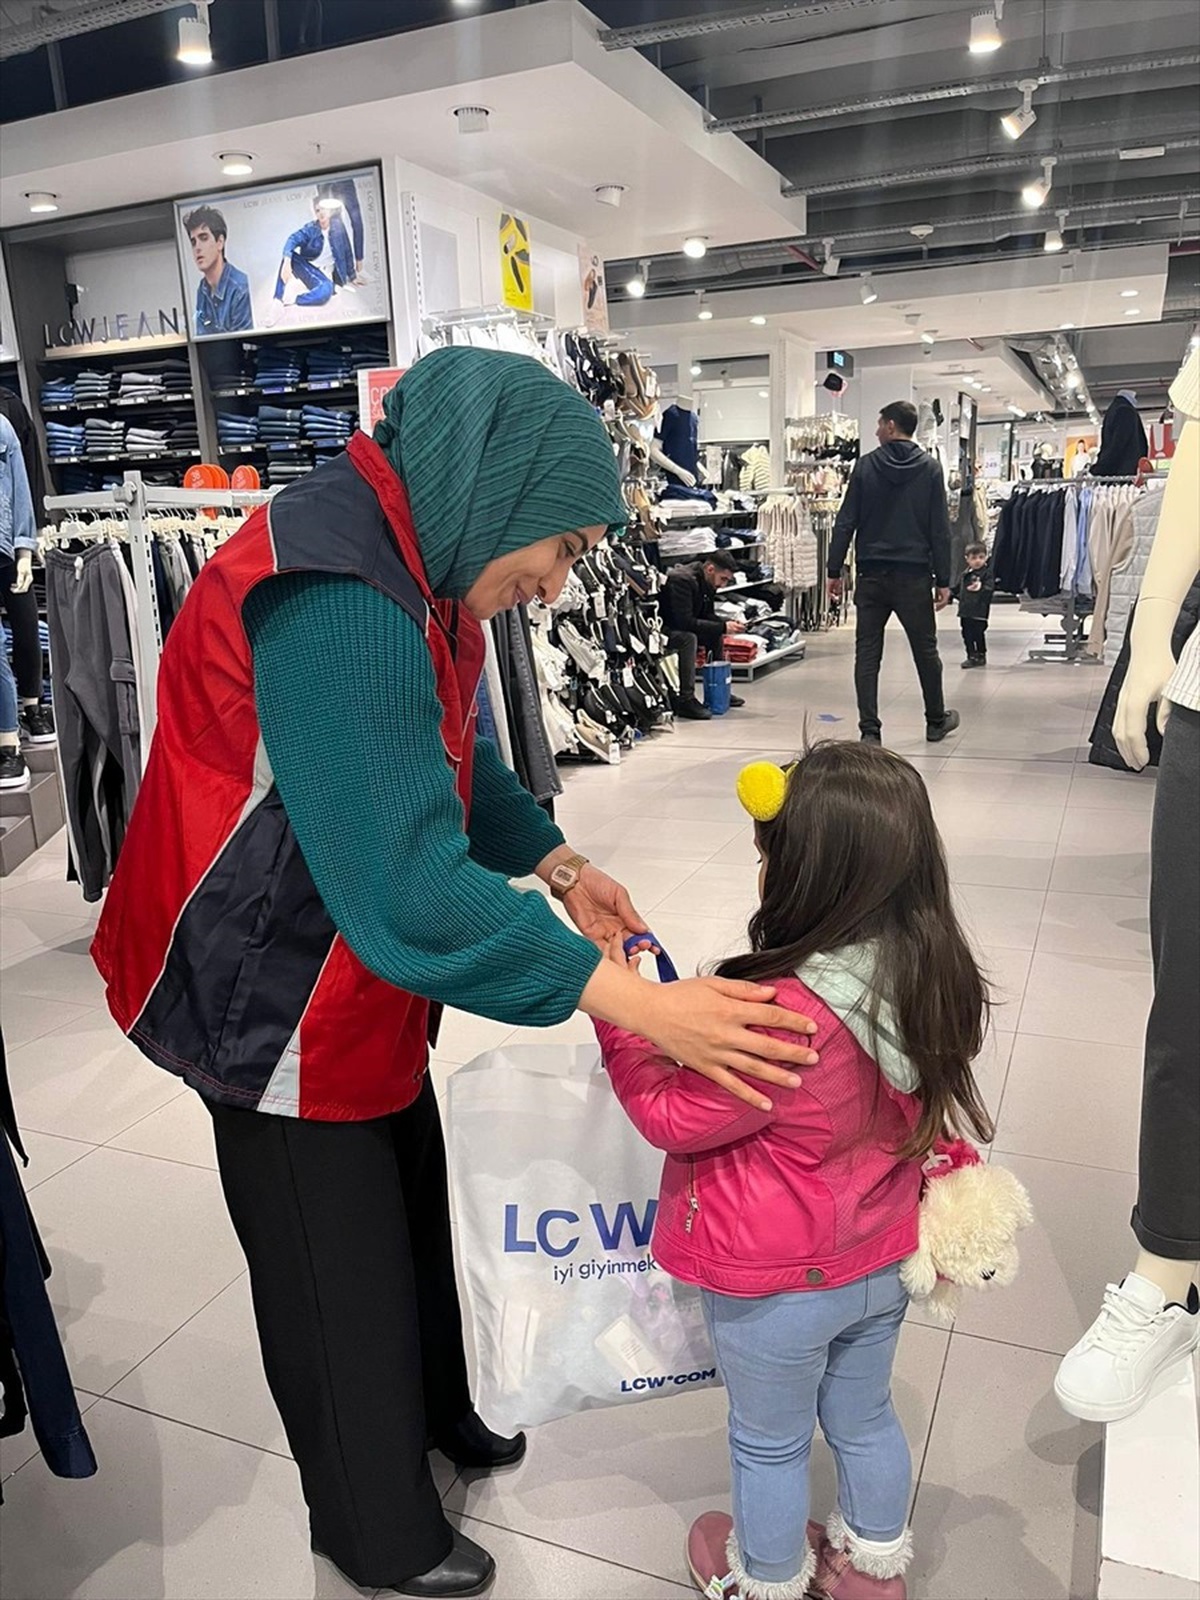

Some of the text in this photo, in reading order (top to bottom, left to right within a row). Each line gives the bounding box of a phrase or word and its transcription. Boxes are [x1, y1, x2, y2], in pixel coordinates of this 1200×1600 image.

[504, 1204, 580, 1257] LC
[554, 1253, 657, 1284] iyi giyinmek
